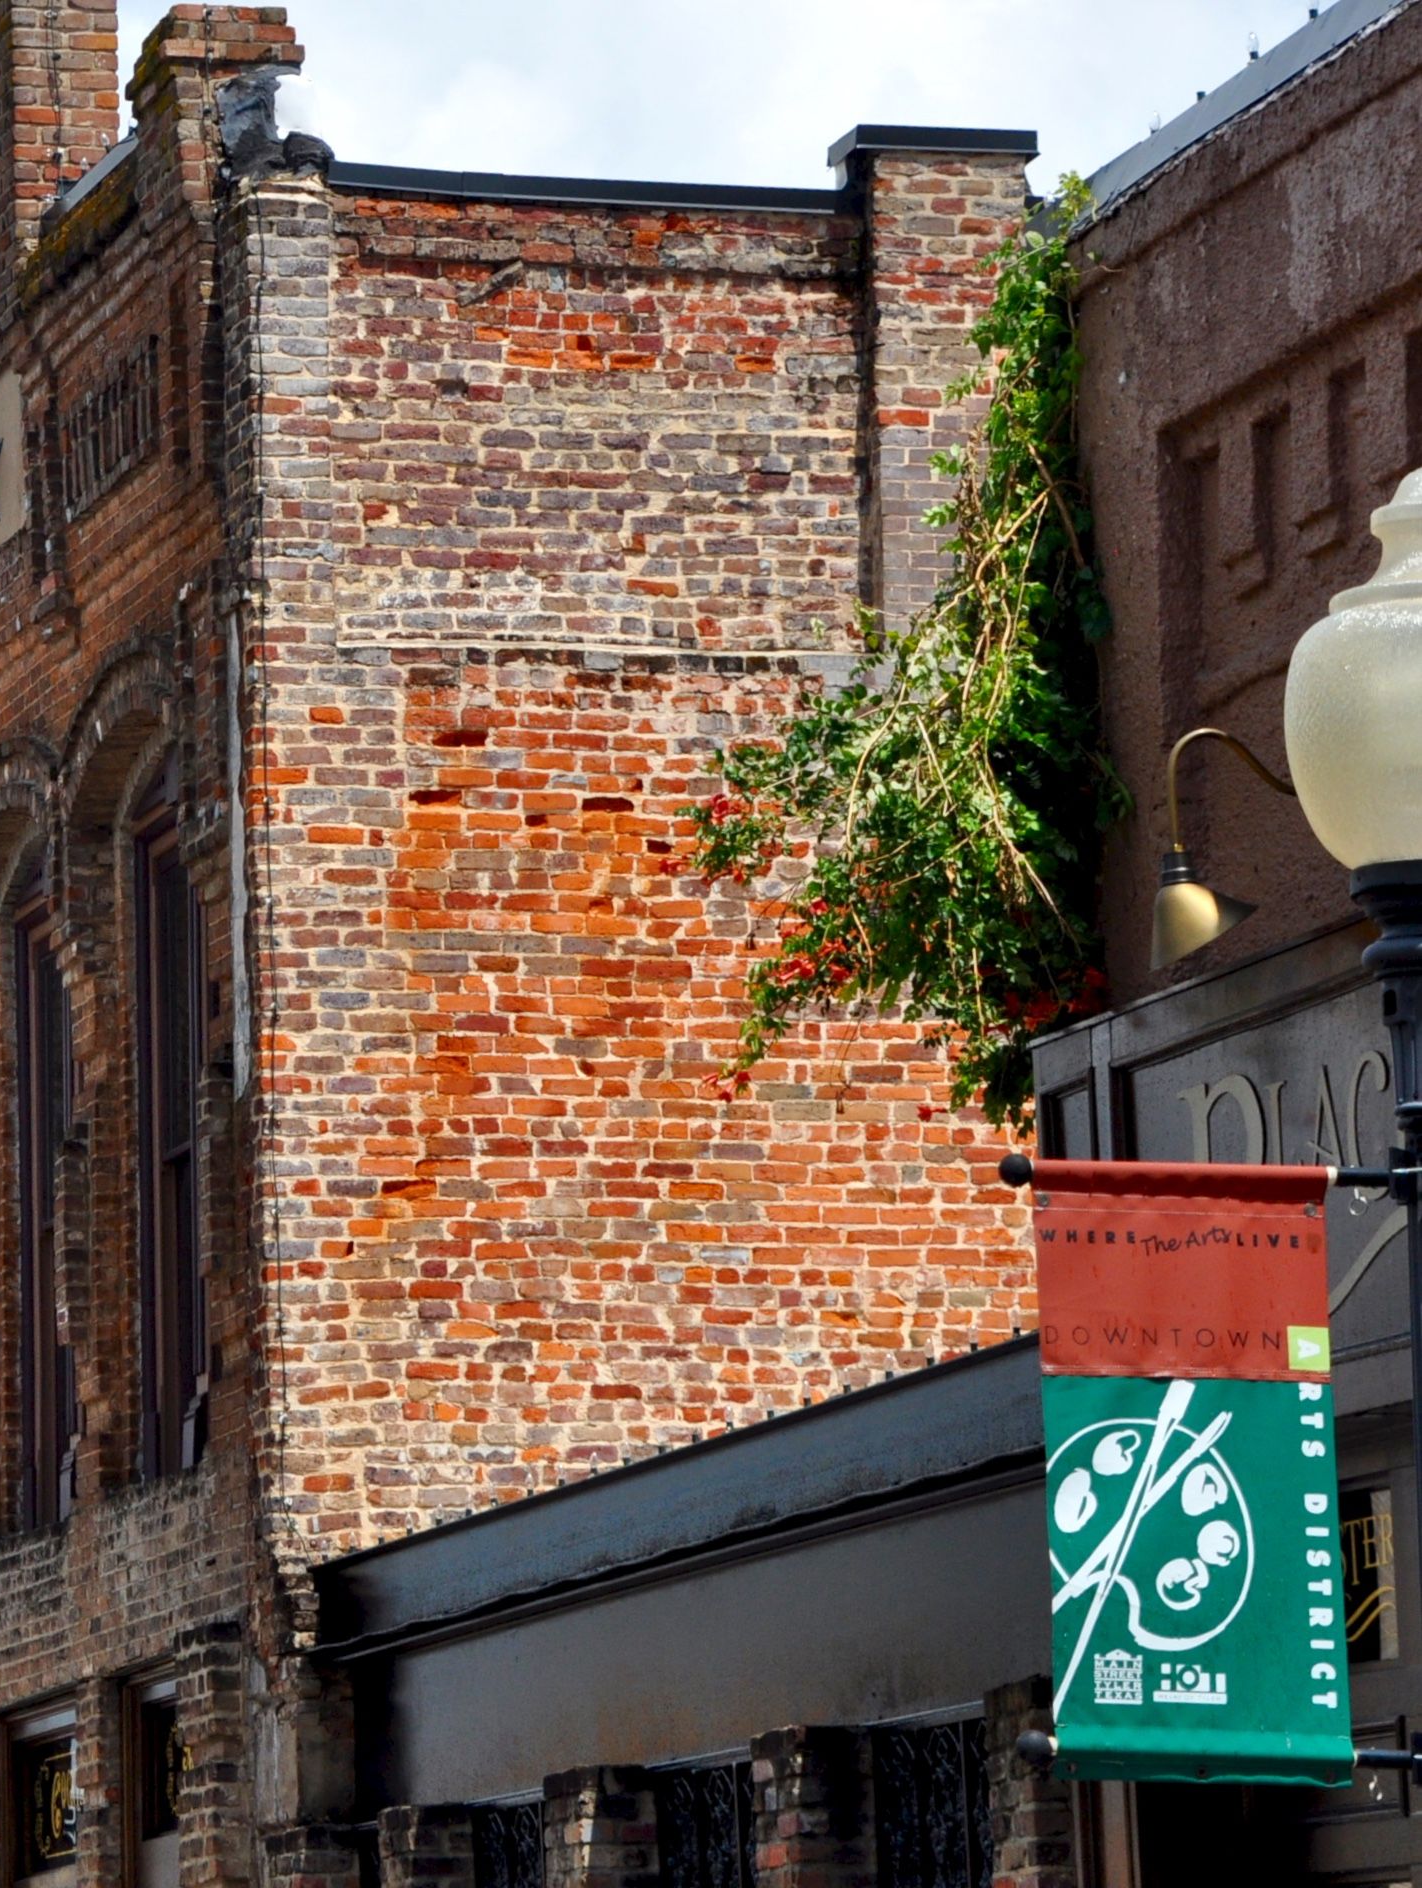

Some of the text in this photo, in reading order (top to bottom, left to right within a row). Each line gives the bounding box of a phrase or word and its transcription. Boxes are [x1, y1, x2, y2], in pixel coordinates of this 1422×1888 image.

[1180, 1050, 1406, 1200] PLAC
[1039, 1227, 1300, 1257] WHERE The Arts LIVE
[1044, 1325, 1281, 1350] DOWNTOWN
[1297, 1338, 1339, 1709] ARTS DISTRICT
[1341, 1514, 1394, 1587] TER
[1094, 1659, 1142, 1669] MAIN
[1094, 1670, 1142, 1679] STREET
[1094, 1680, 1142, 1690] TYLER
[1094, 1690, 1142, 1699] TEXAS
